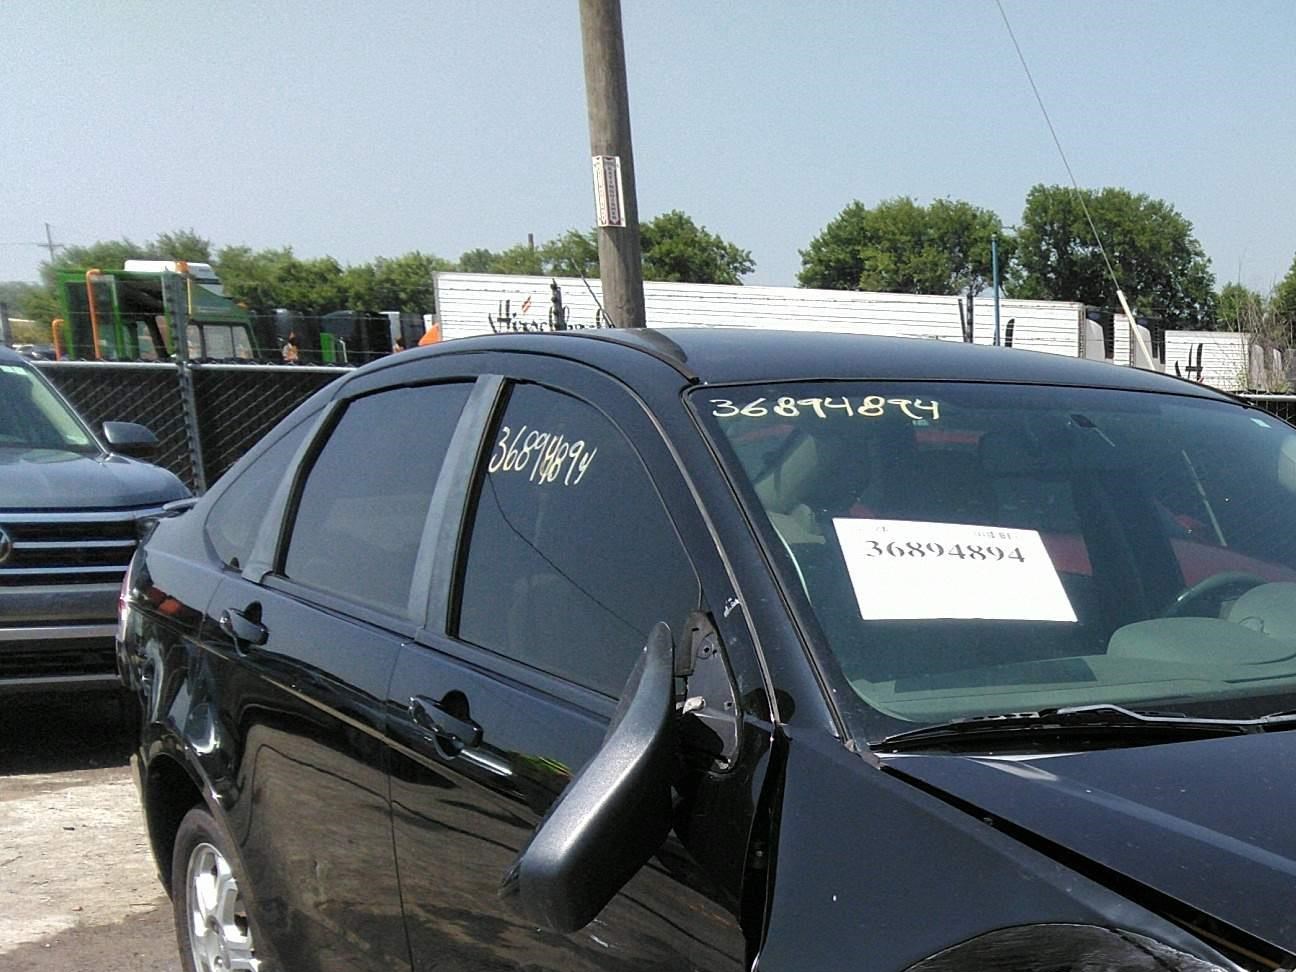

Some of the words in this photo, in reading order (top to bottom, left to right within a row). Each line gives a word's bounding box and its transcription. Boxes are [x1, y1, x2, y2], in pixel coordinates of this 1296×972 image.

[709, 394, 941, 421] 36894894
[488, 424, 598, 486] 36894894
[864, 539, 1026, 564] 36894894
